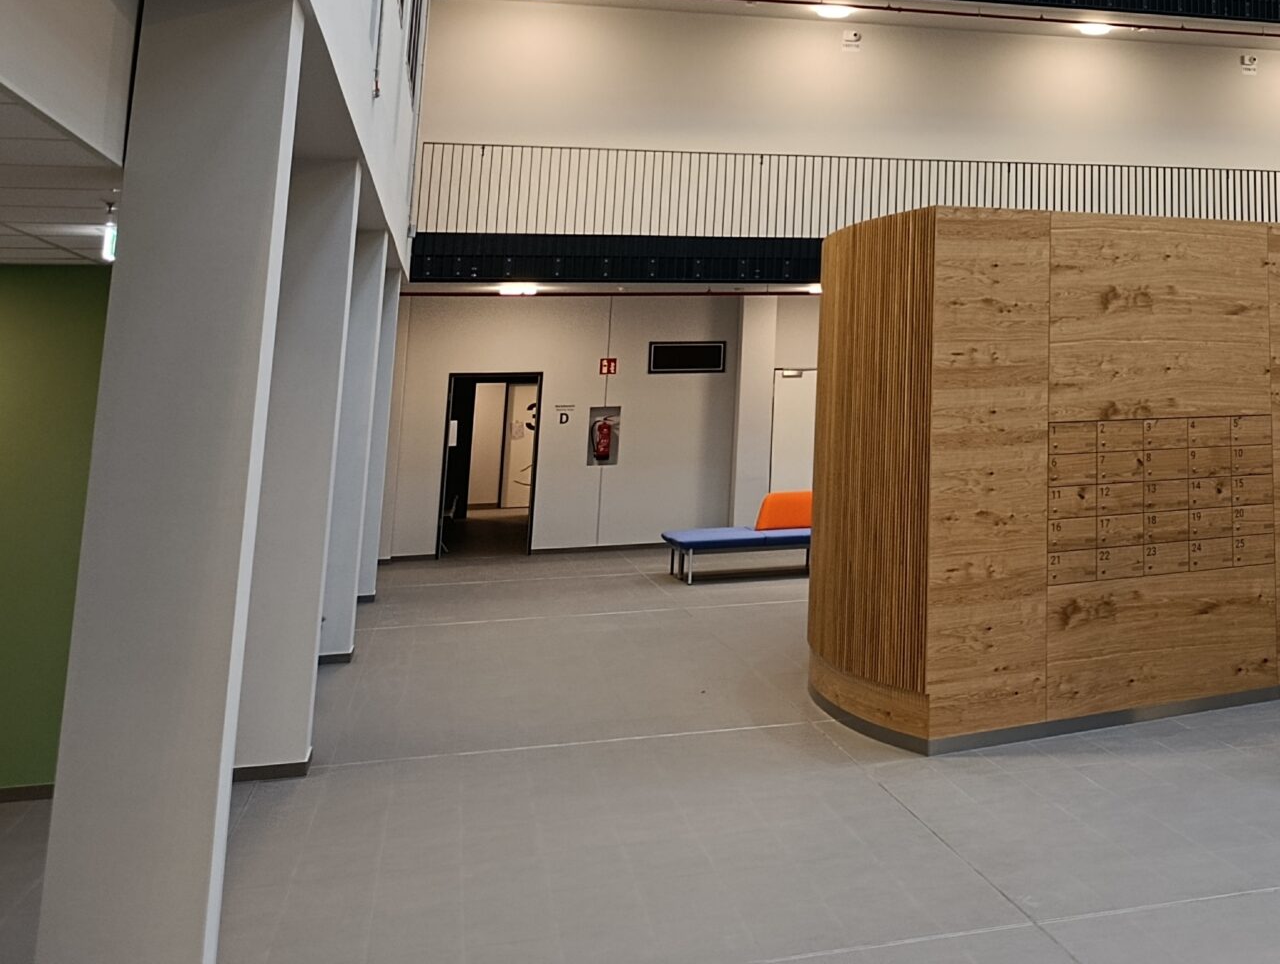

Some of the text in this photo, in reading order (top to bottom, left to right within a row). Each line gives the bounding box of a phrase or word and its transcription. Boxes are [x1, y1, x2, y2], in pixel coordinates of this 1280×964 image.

[560, 413, 569, 424] D
[1191, 421, 1195, 429] 4
[1233, 419, 1238, 427] 5
[1052, 426, 1056, 434] 1
[1146, 423, 1151, 432] 3
[1234, 449, 1243, 457] 10
[1100, 456, 1105, 464] 7
[1147, 453, 1151, 462] 8
[1052, 458, 1057, 466] 6
[1192, 481, 1201, 490] 14
[1235, 479, 1243, 487] 15
[1100, 488, 1110, 496] 12
[1147, 484, 1156, 492] 13
[1052, 490, 1061, 499] 11
[1147, 516, 1156, 524] 18
[1192, 513, 1201, 521] 19
[1052, 523, 1061, 532] 16
[1100, 519, 1110, 528] 17
[1192, 543, 1201, 552] 24
[1235, 540, 1244, 548] 25
[1147, 547, 1156, 556] 23
[1050, 556, 1060, 564] 21
[1099, 552, 1110, 560] 22
